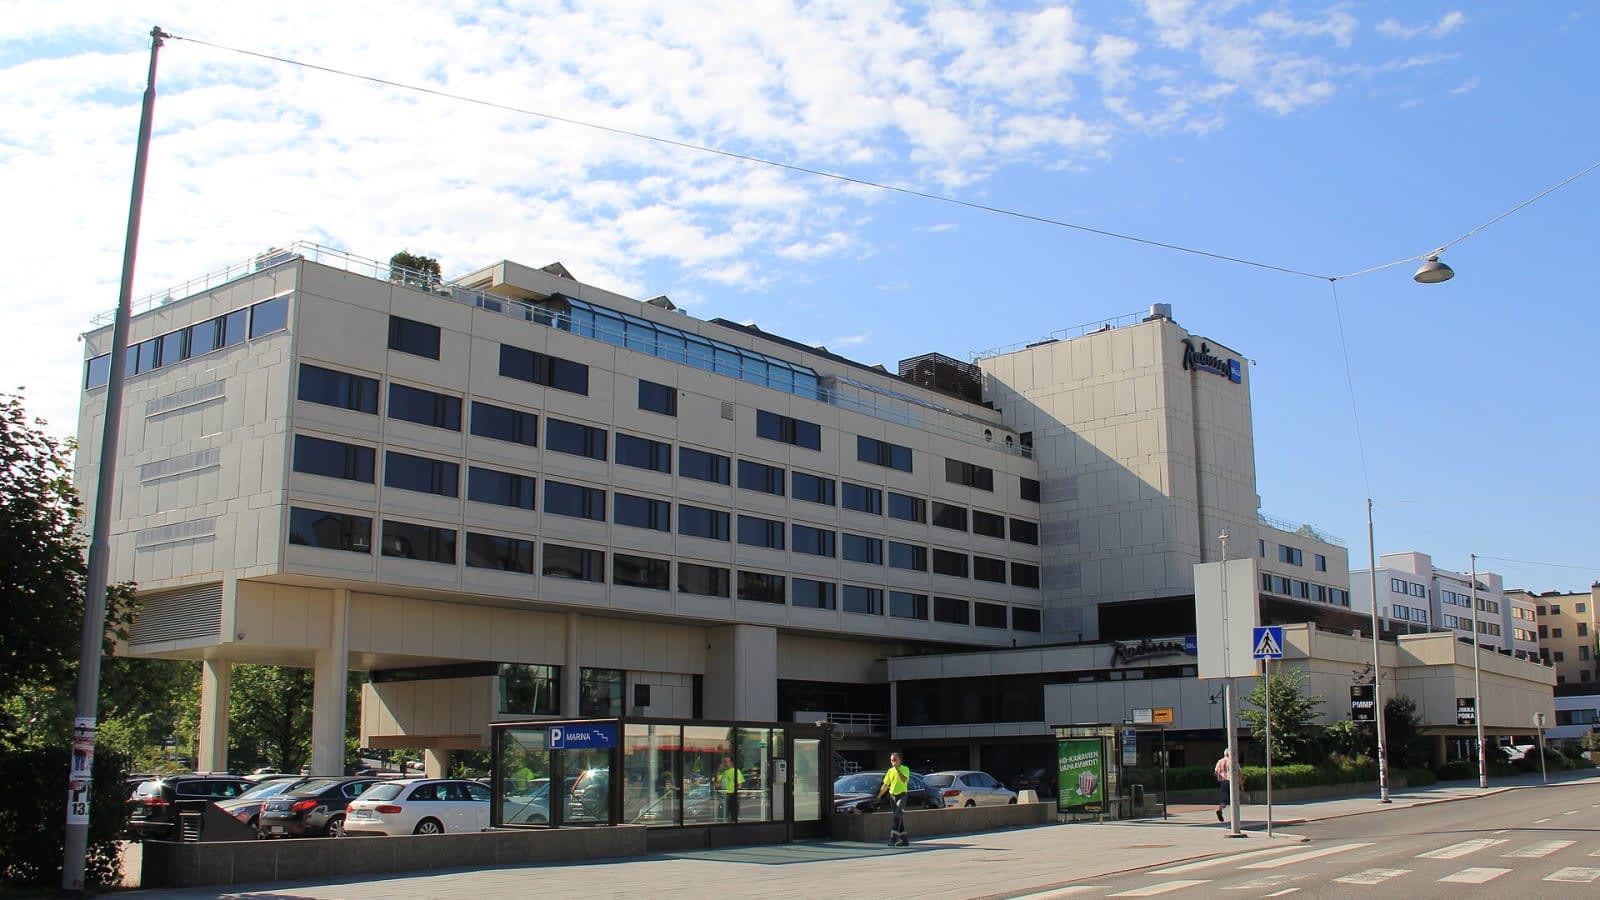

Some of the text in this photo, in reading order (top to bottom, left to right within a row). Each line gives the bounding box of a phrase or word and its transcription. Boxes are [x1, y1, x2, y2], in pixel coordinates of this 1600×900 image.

[1181, 339, 1230, 377] Radisson
[1352, 701, 1373, 709] PMMP
[551, 729, 591, 746] P MARINA
